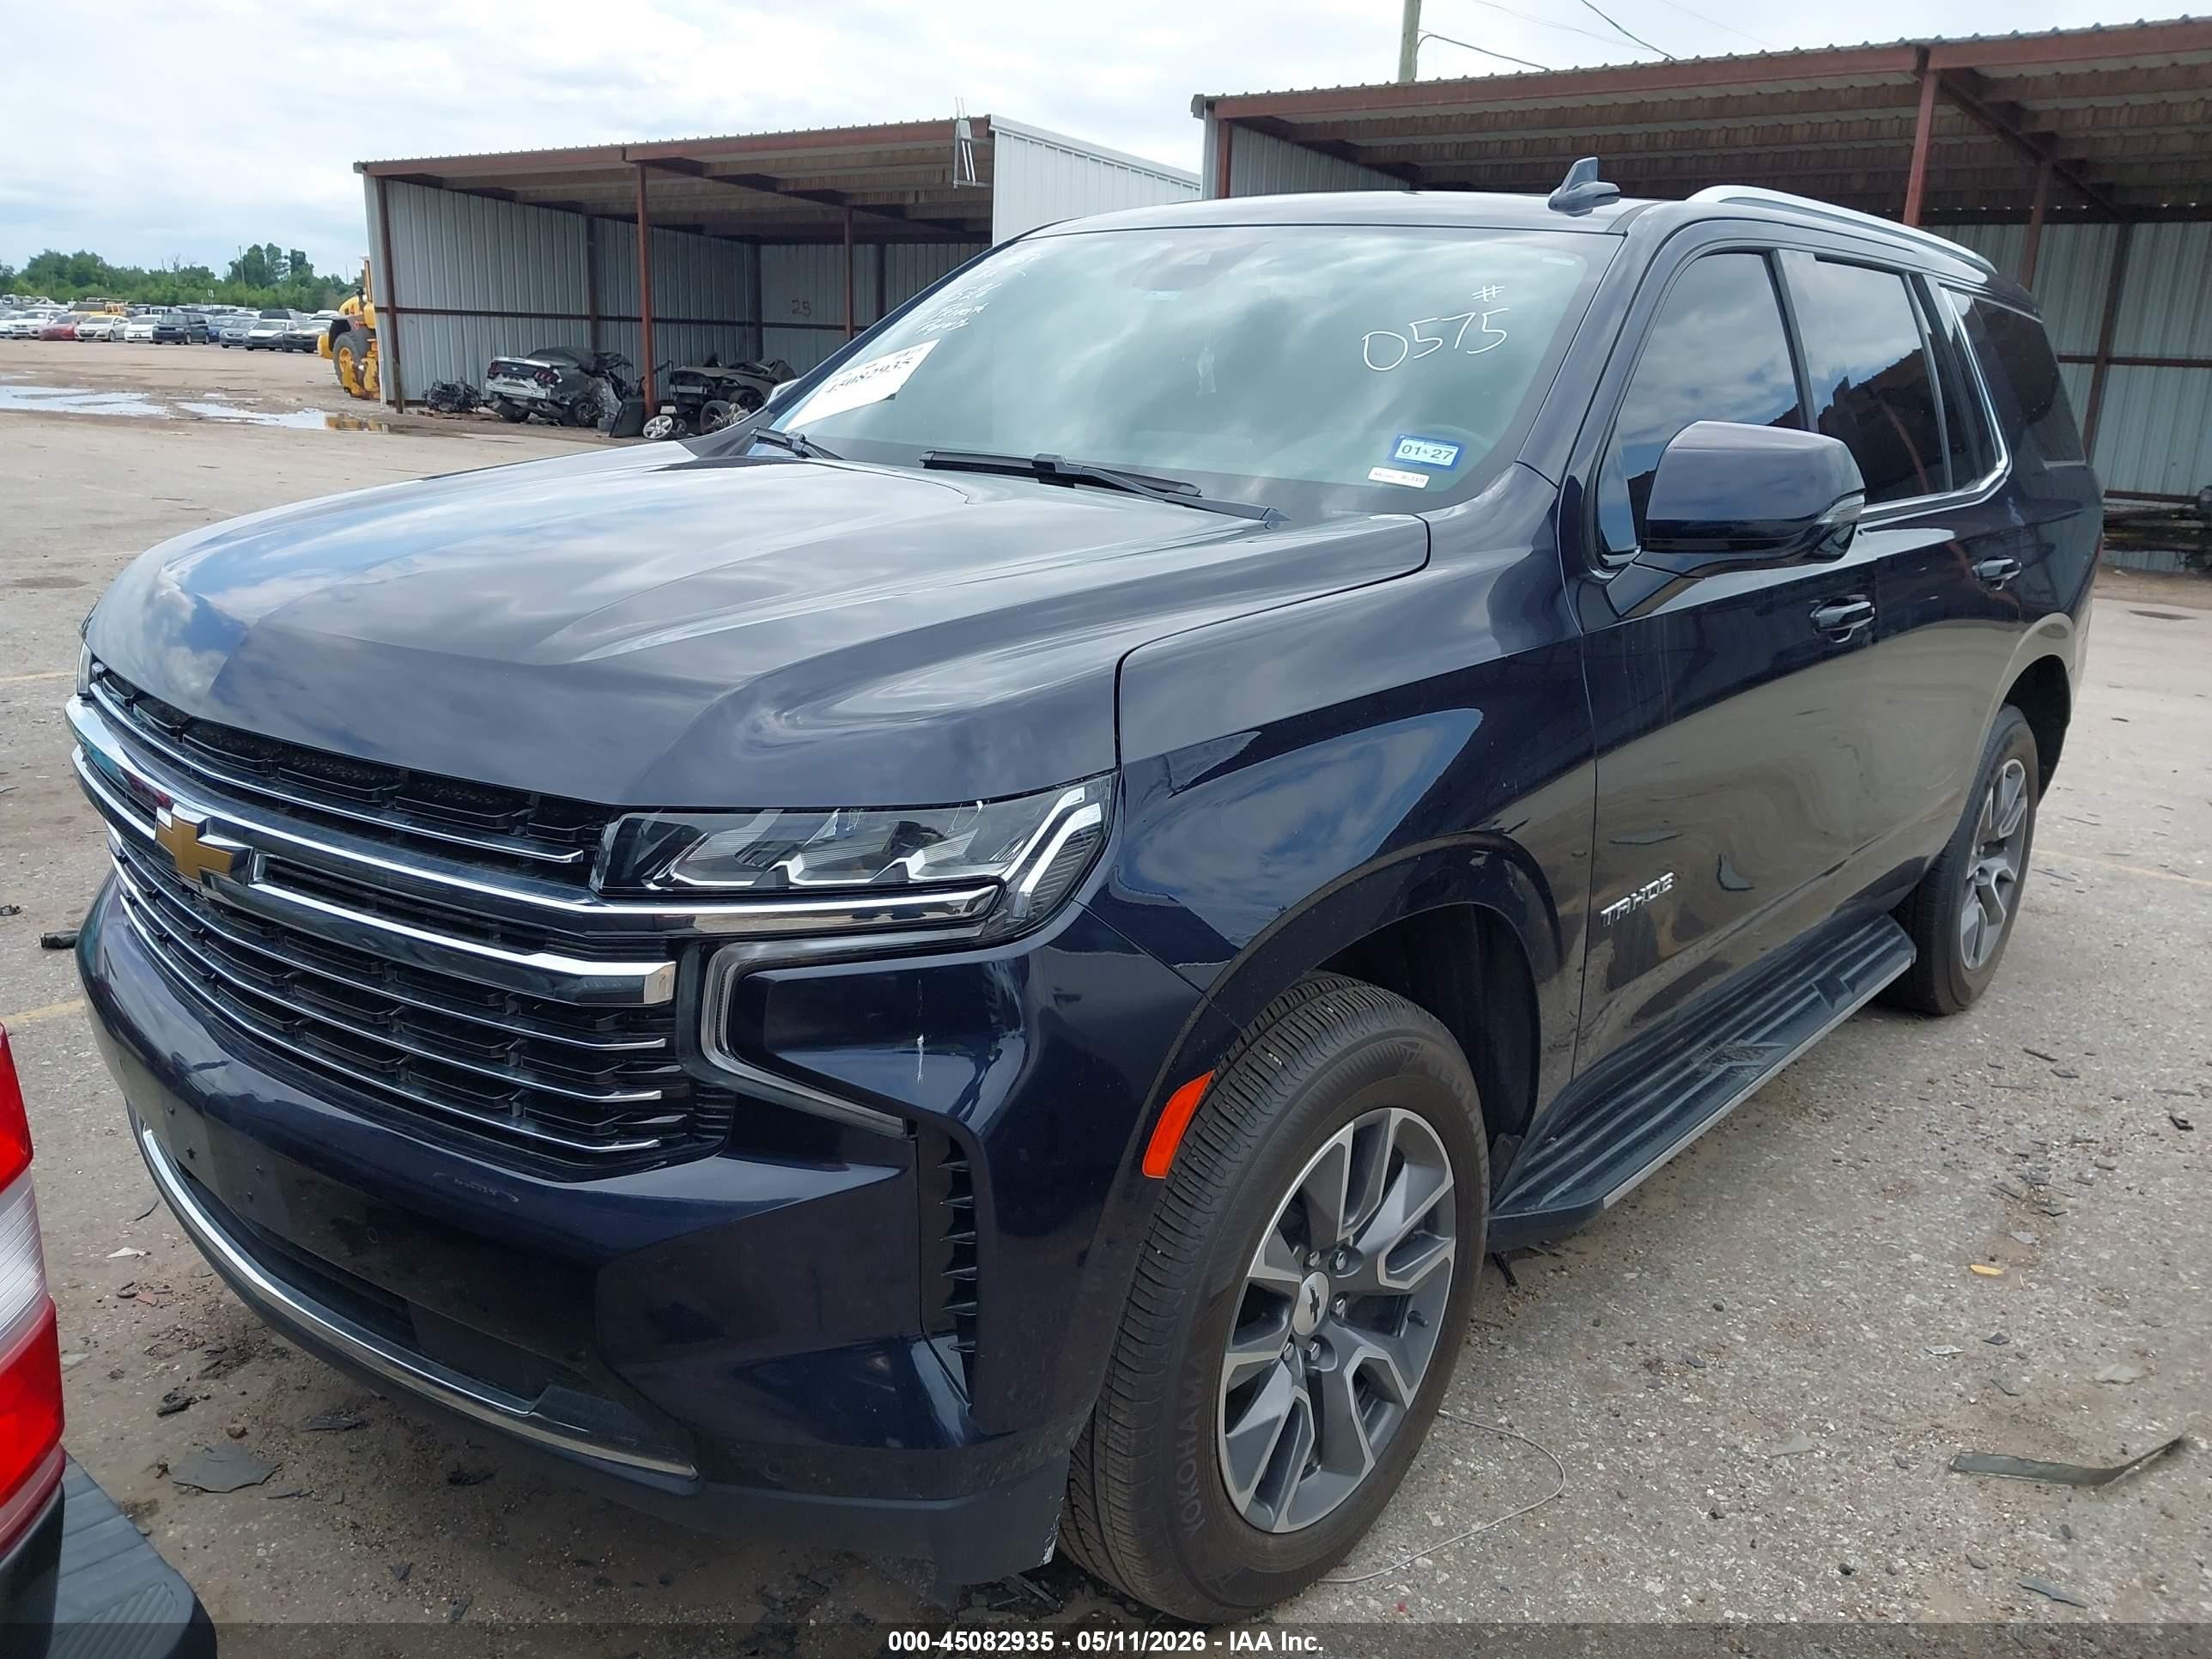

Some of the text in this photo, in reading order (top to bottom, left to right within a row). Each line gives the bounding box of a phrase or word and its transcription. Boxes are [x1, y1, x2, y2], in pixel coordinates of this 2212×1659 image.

[1361, 307, 1510, 371] 0575
[1600, 872, 1675, 927] TAHOE
[1175, 1347, 1210, 1540] YOKOHAMA
